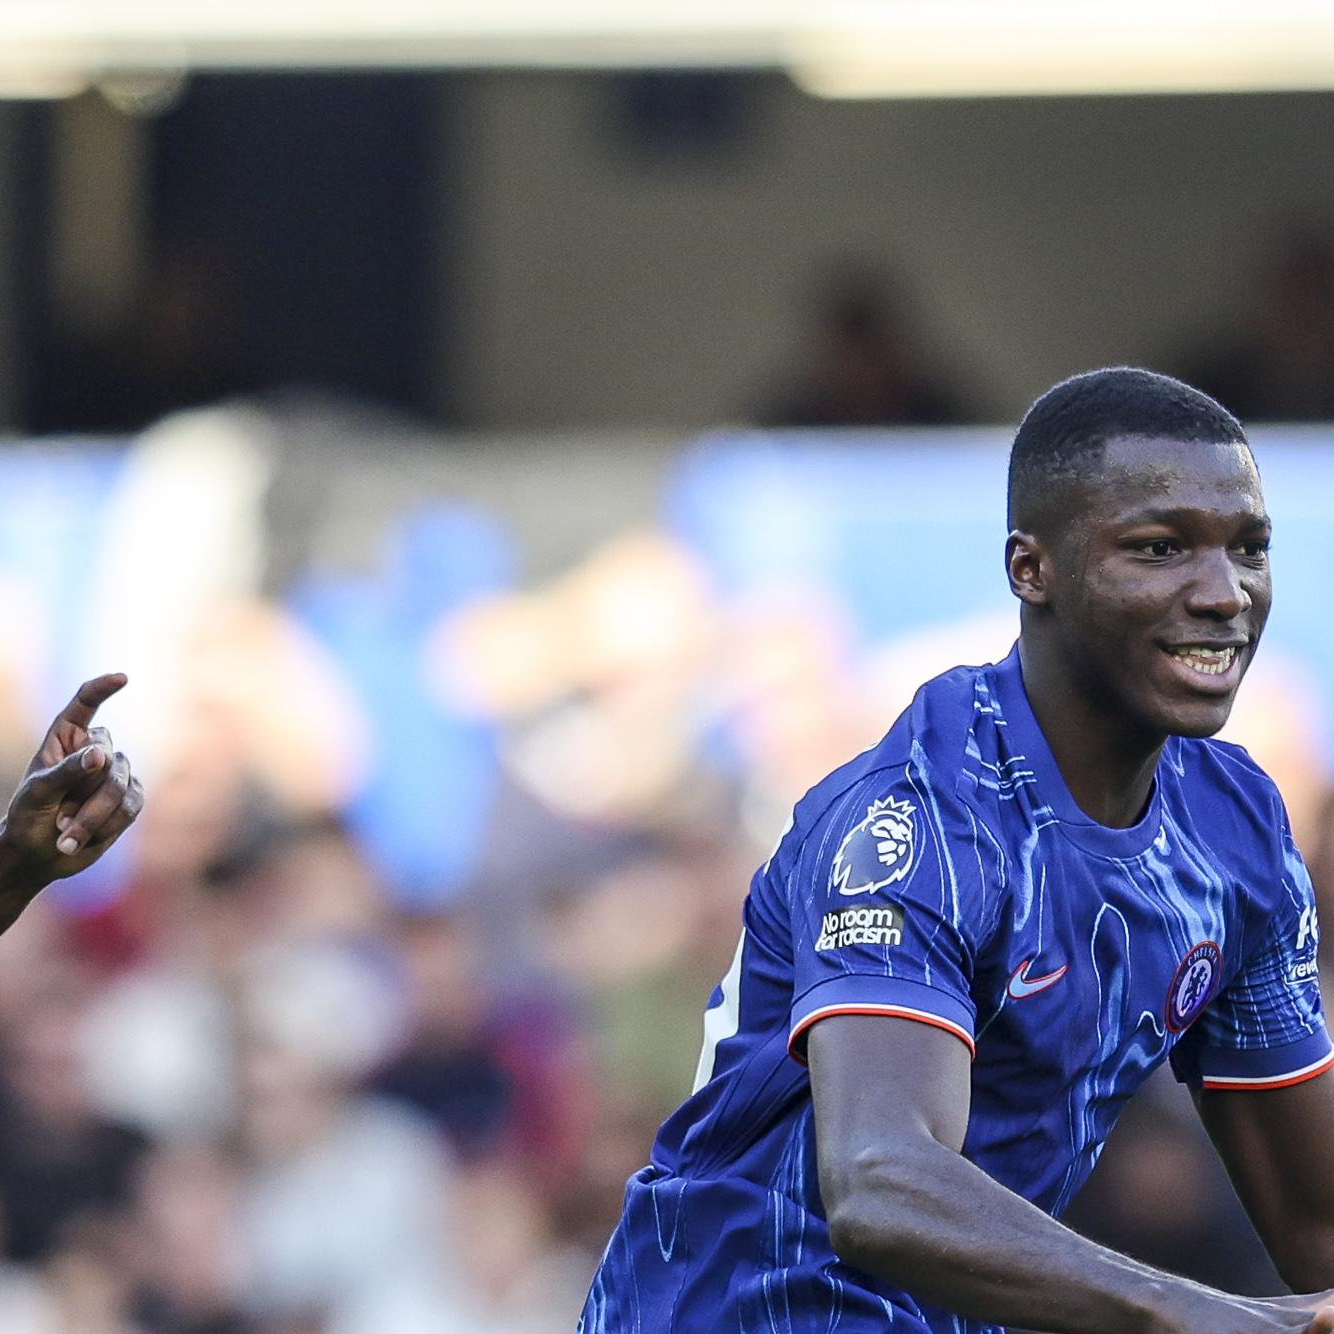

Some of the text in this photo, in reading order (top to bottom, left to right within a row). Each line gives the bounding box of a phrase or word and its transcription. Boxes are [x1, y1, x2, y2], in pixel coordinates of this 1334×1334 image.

[822, 908, 893, 934] No room
[838, 927, 901, 948] racism
